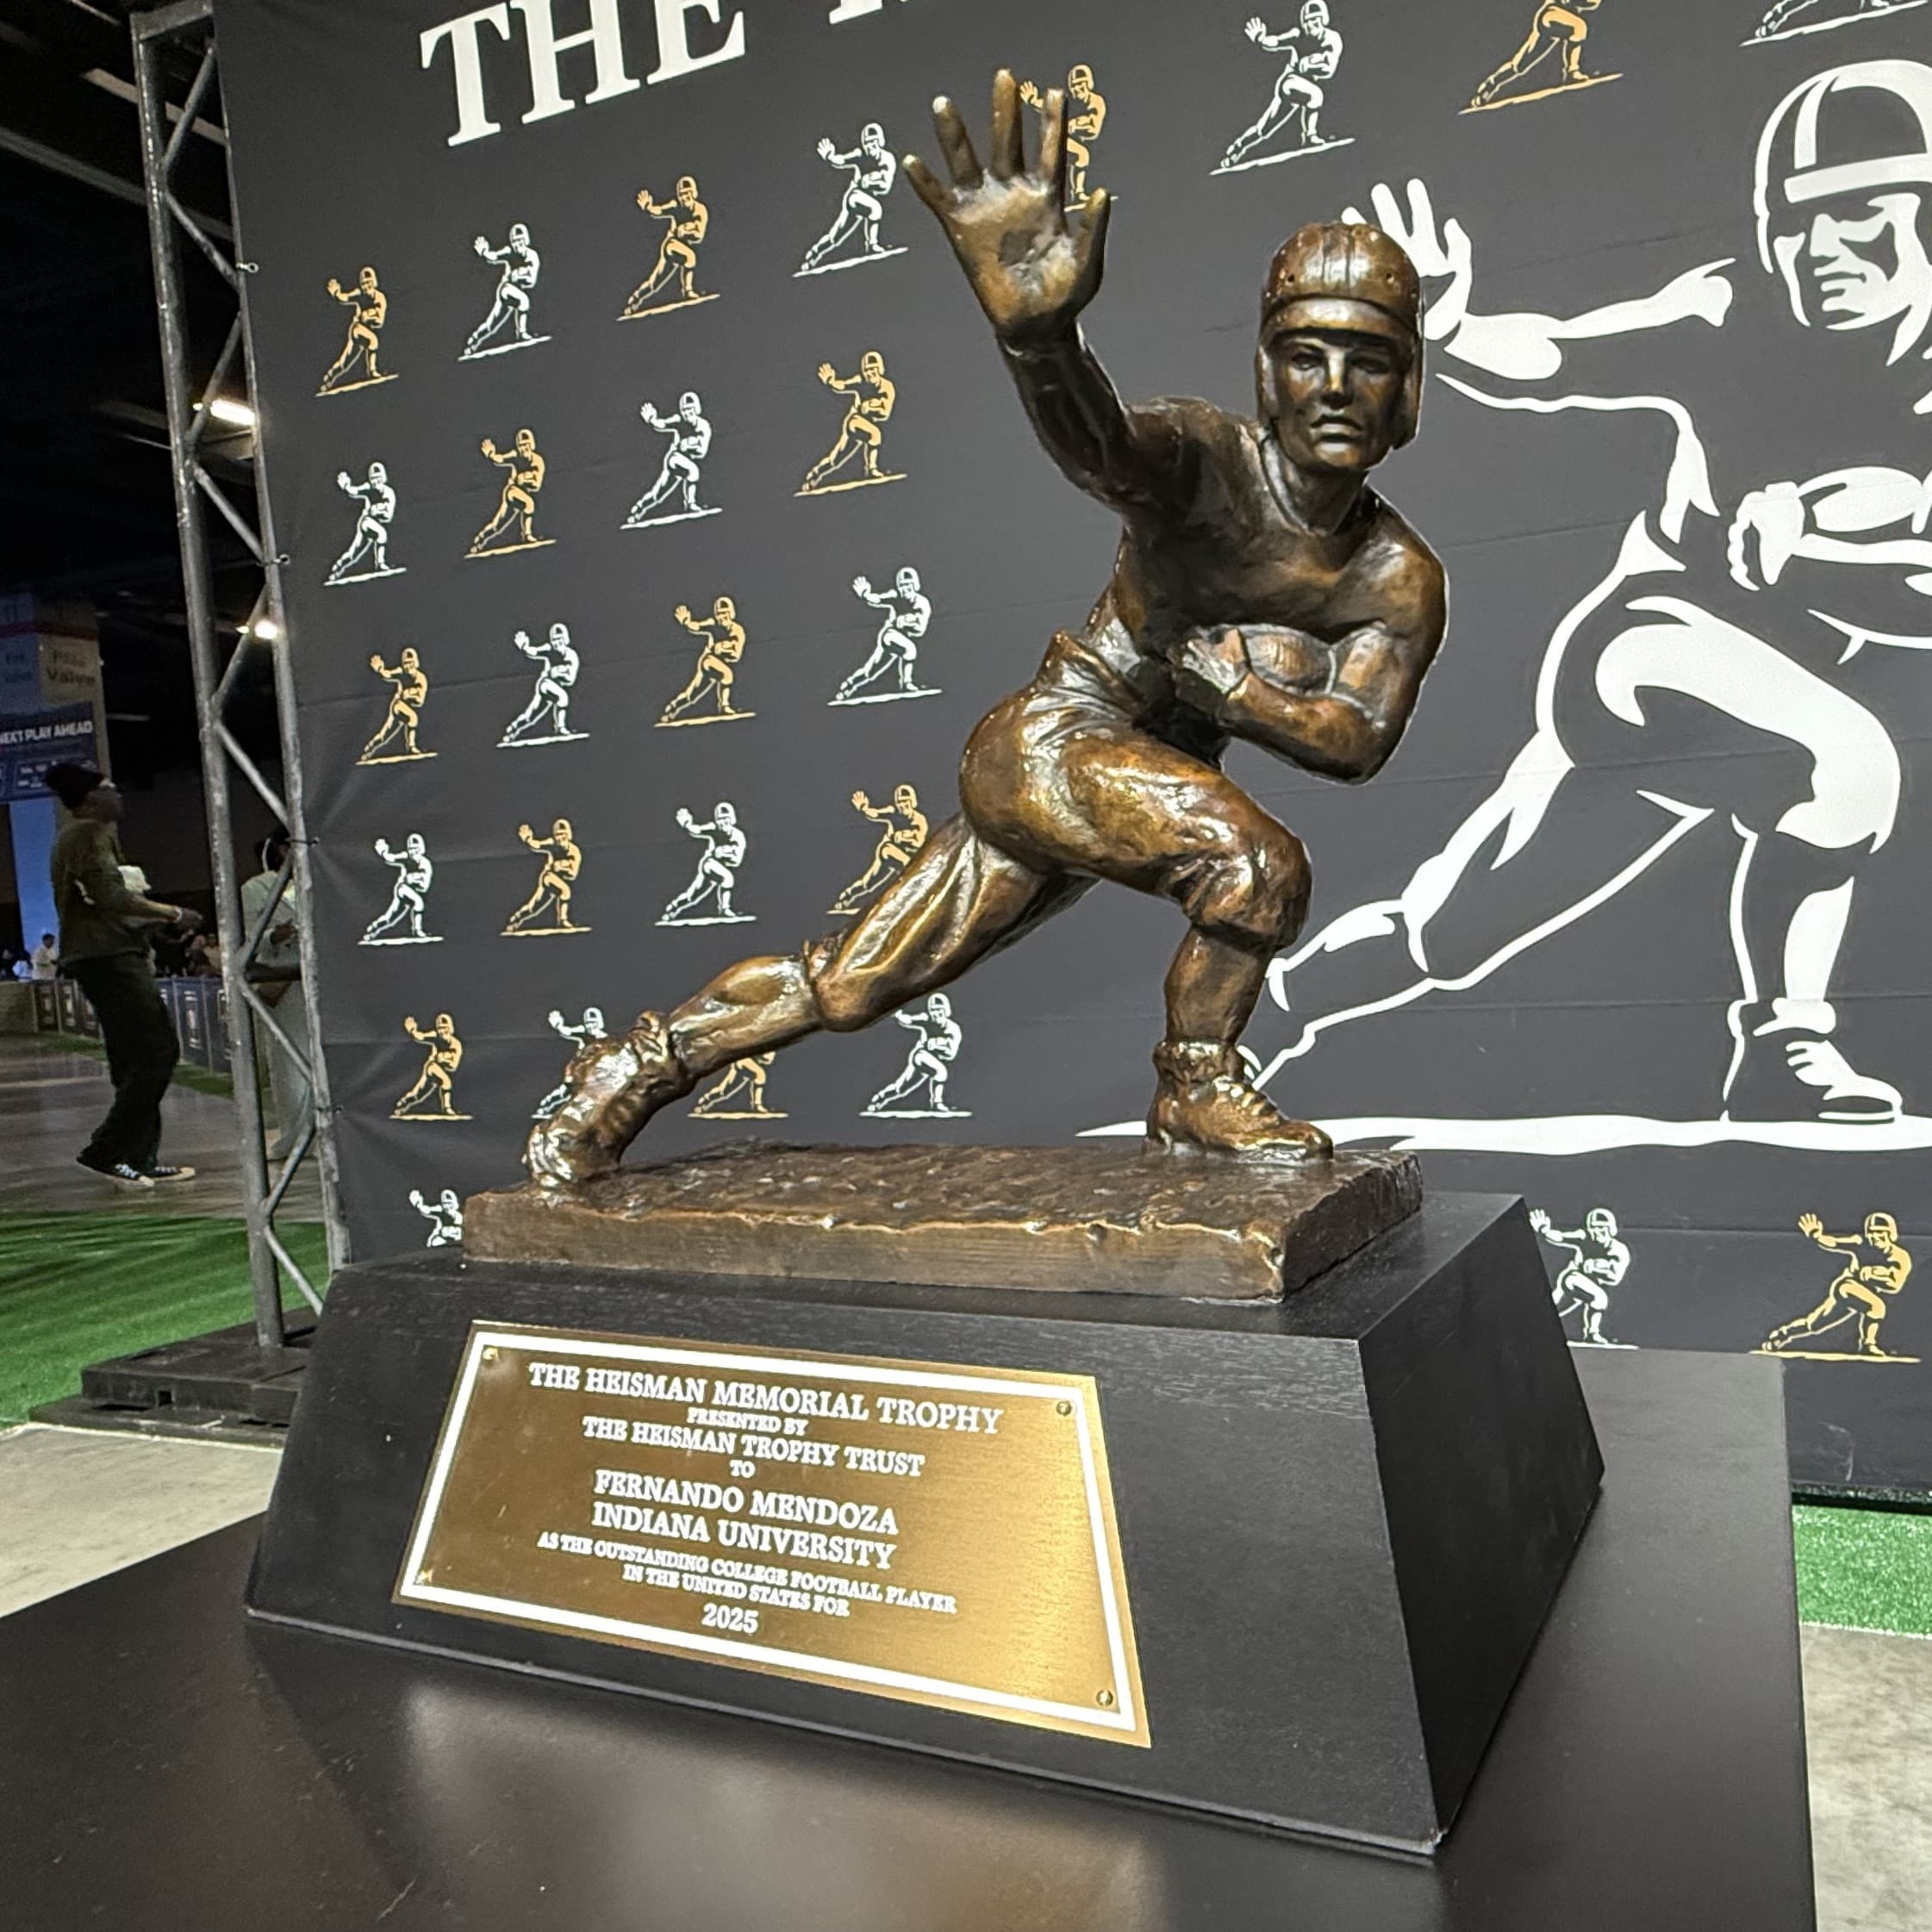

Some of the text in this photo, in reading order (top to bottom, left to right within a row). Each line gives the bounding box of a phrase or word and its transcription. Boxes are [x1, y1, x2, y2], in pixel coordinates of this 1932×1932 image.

[420, 0, 745, 146] THE
[24, 726, 52, 741] PLAY
[53, 720, 93, 738] AHEAD
[528, 1362, 1004, 1435] THE HEISMAN MEMORIAL TROPHY
[686, 1406, 808, 1437] PRESENTED BY
[583, 1416, 925, 1477] THE HEISMAN TROPHY TRUST
[729, 1459, 756, 1479] TO
[594, 1469, 899, 1536] FERNANDO MENDOZA
[591, 1501, 897, 1570] INDIANA UNIVERSITY
[537, 1531, 957, 1614] AS THE OUTSTANDING COLLEGE FOOTBALL PLAYER
[622, 1563, 851, 1617] IN THE UNITED STATES FOR
[701, 1603, 759, 1634] 2025
